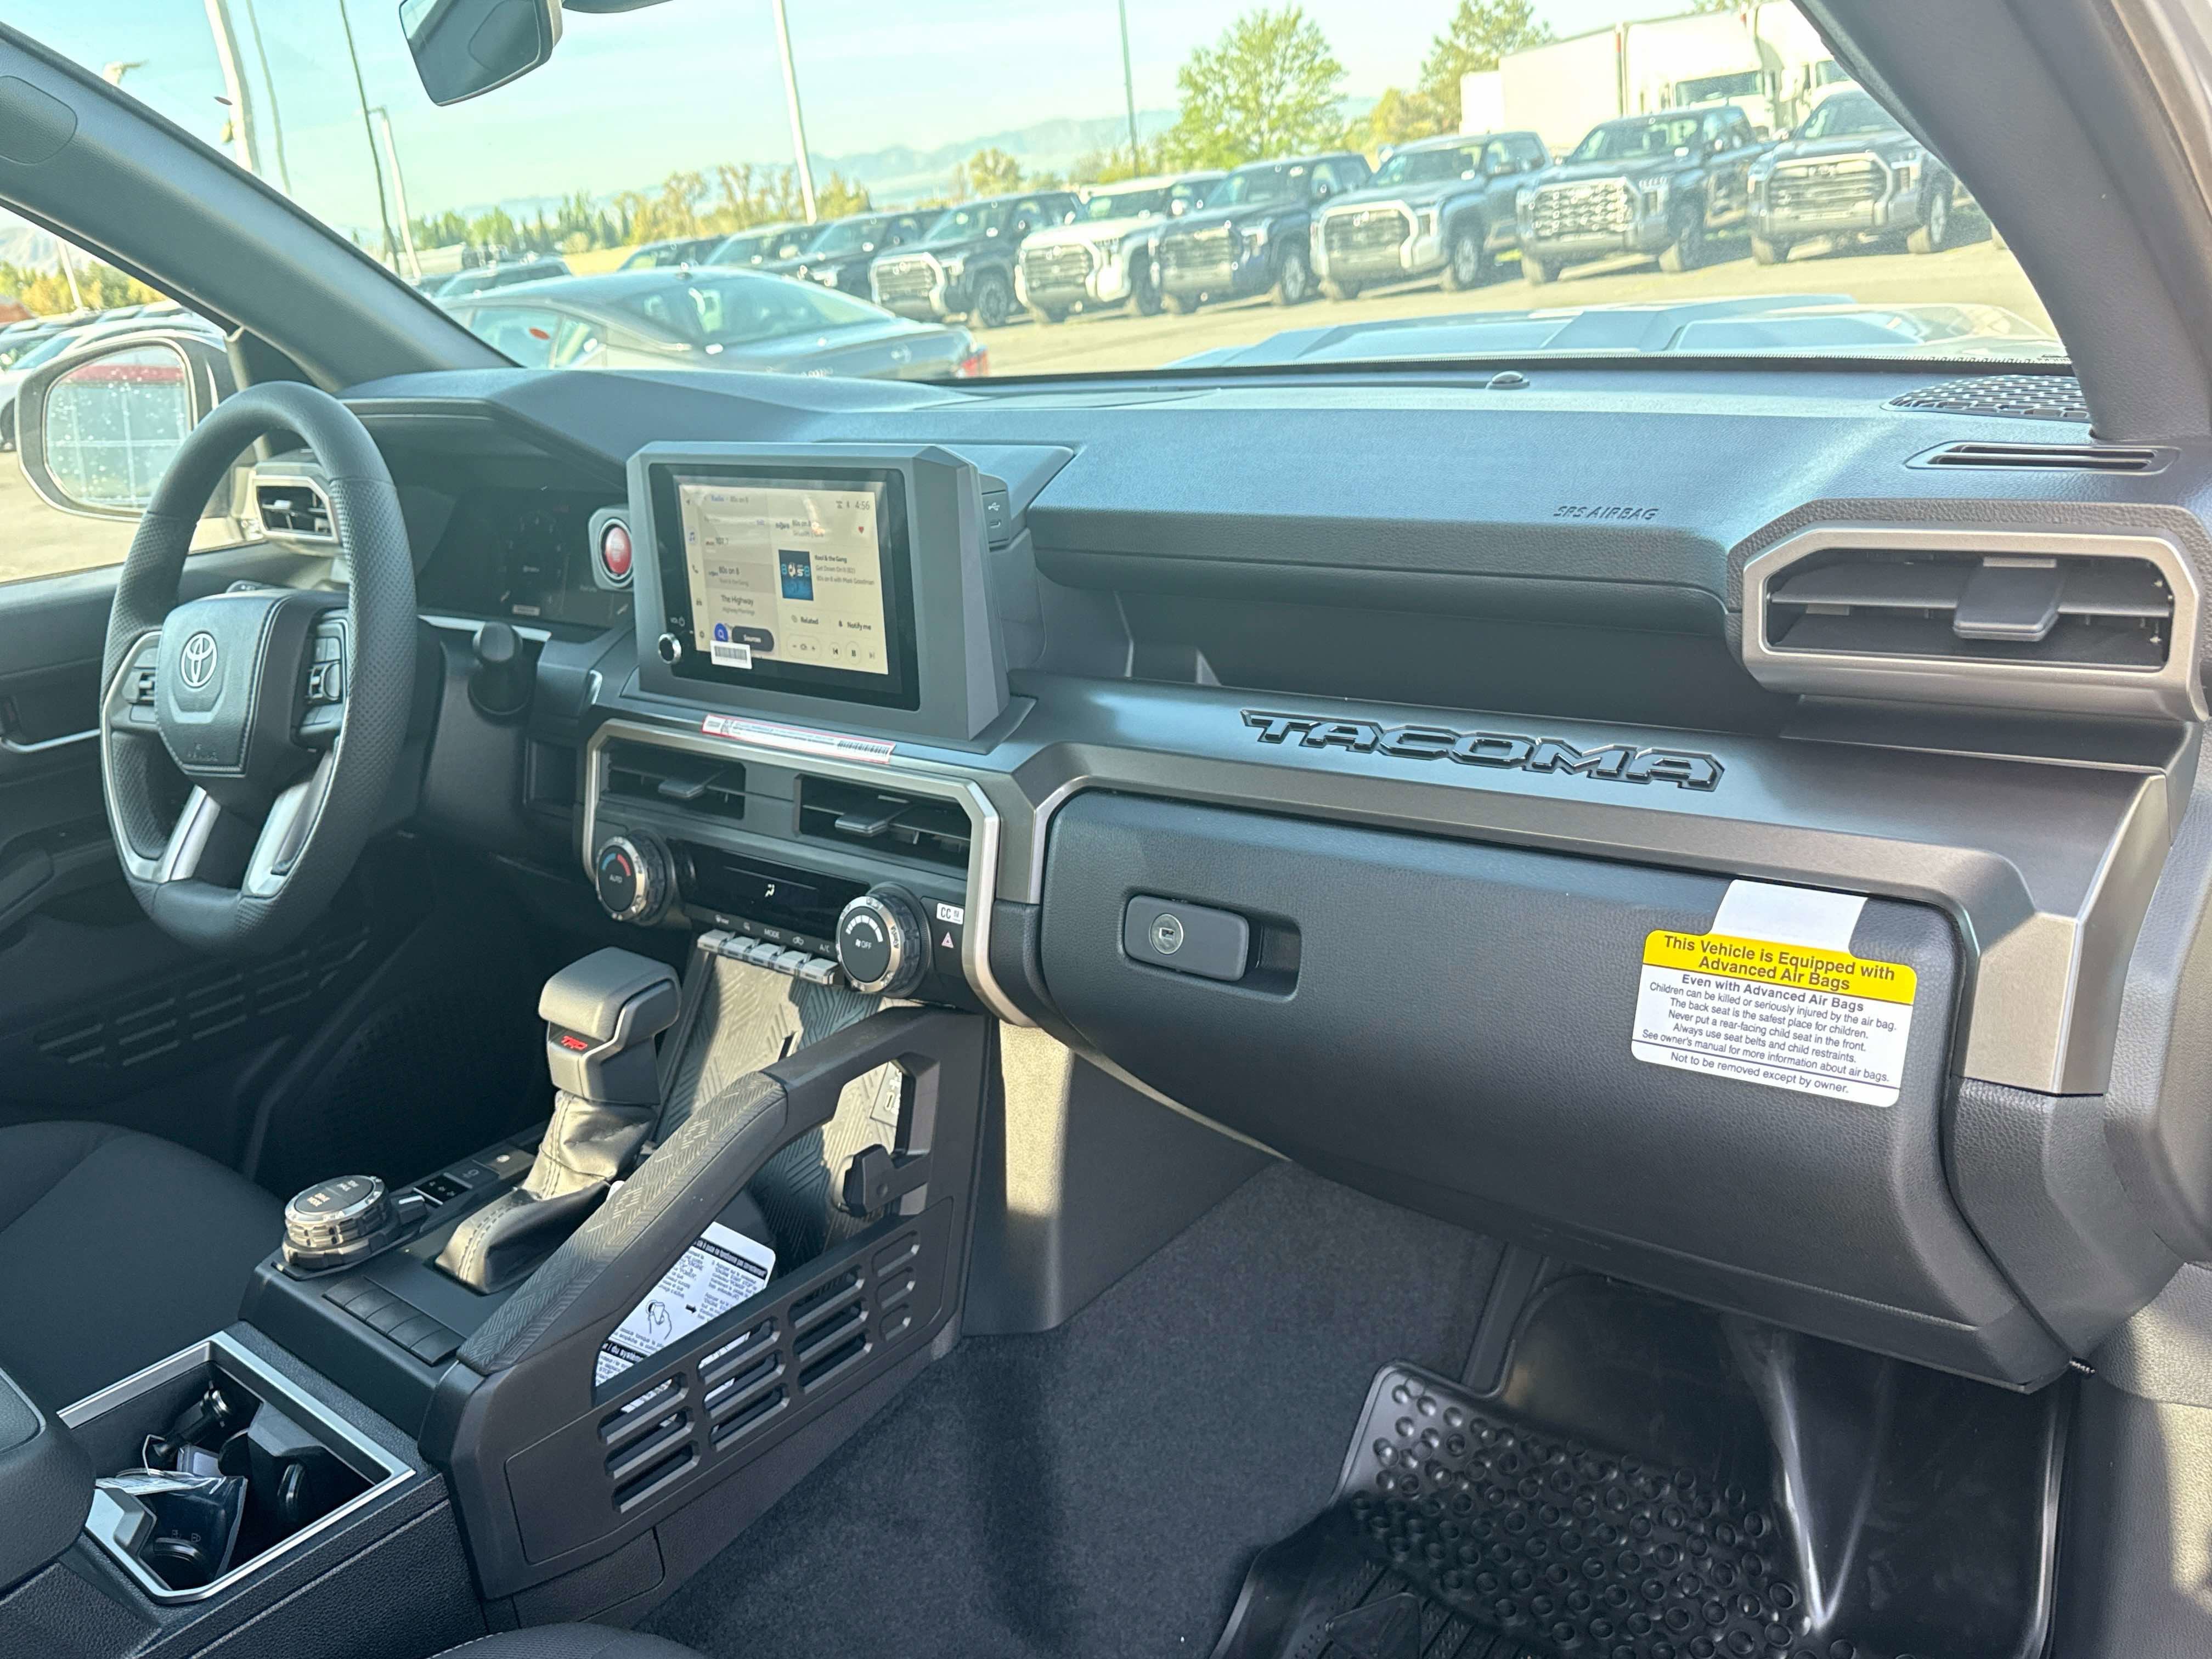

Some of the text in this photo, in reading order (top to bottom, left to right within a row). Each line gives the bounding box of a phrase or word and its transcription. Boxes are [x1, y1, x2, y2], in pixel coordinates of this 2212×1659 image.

[855, 500, 870, 510] 4:56
[1553, 506, 1659, 520] SRS AIRBAG
[732, 596, 754, 606] Highway
[800, 616, 819, 624] Related
[847, 621, 862, 631] Notify
[1240, 708, 1725, 792] TACOMA
[609, 874, 623, 884] AUTO
[940, 906, 951, 919] CC
[764, 928, 780, 939] MODE
[861, 940, 872, 949] OFF
[819, 944, 830, 953] A/C
[1663, 934, 1895, 981] This Vehicle is Equipped with
[1697, 955, 1850, 992] Advanced Air Bags
[1681, 973, 1864, 1013] Even with Advanced Air Bags
[1649, 981, 1897, 1032] Children can be killed or seriously injured by the air bag.
[1670, 996, 1869, 1039] The back seat is the safest place for children.
[1667, 1008, 1866, 1052] Never put a rear-facing child seat in the front.
[1672, 1022, 1857, 1063] Always use seat belts and child restraints.
[1641, 1028, 1889, 1082] See owner's manual for more information about air bags.
[1670, 1051, 1849, 1093] Not to be removed except by owner.
